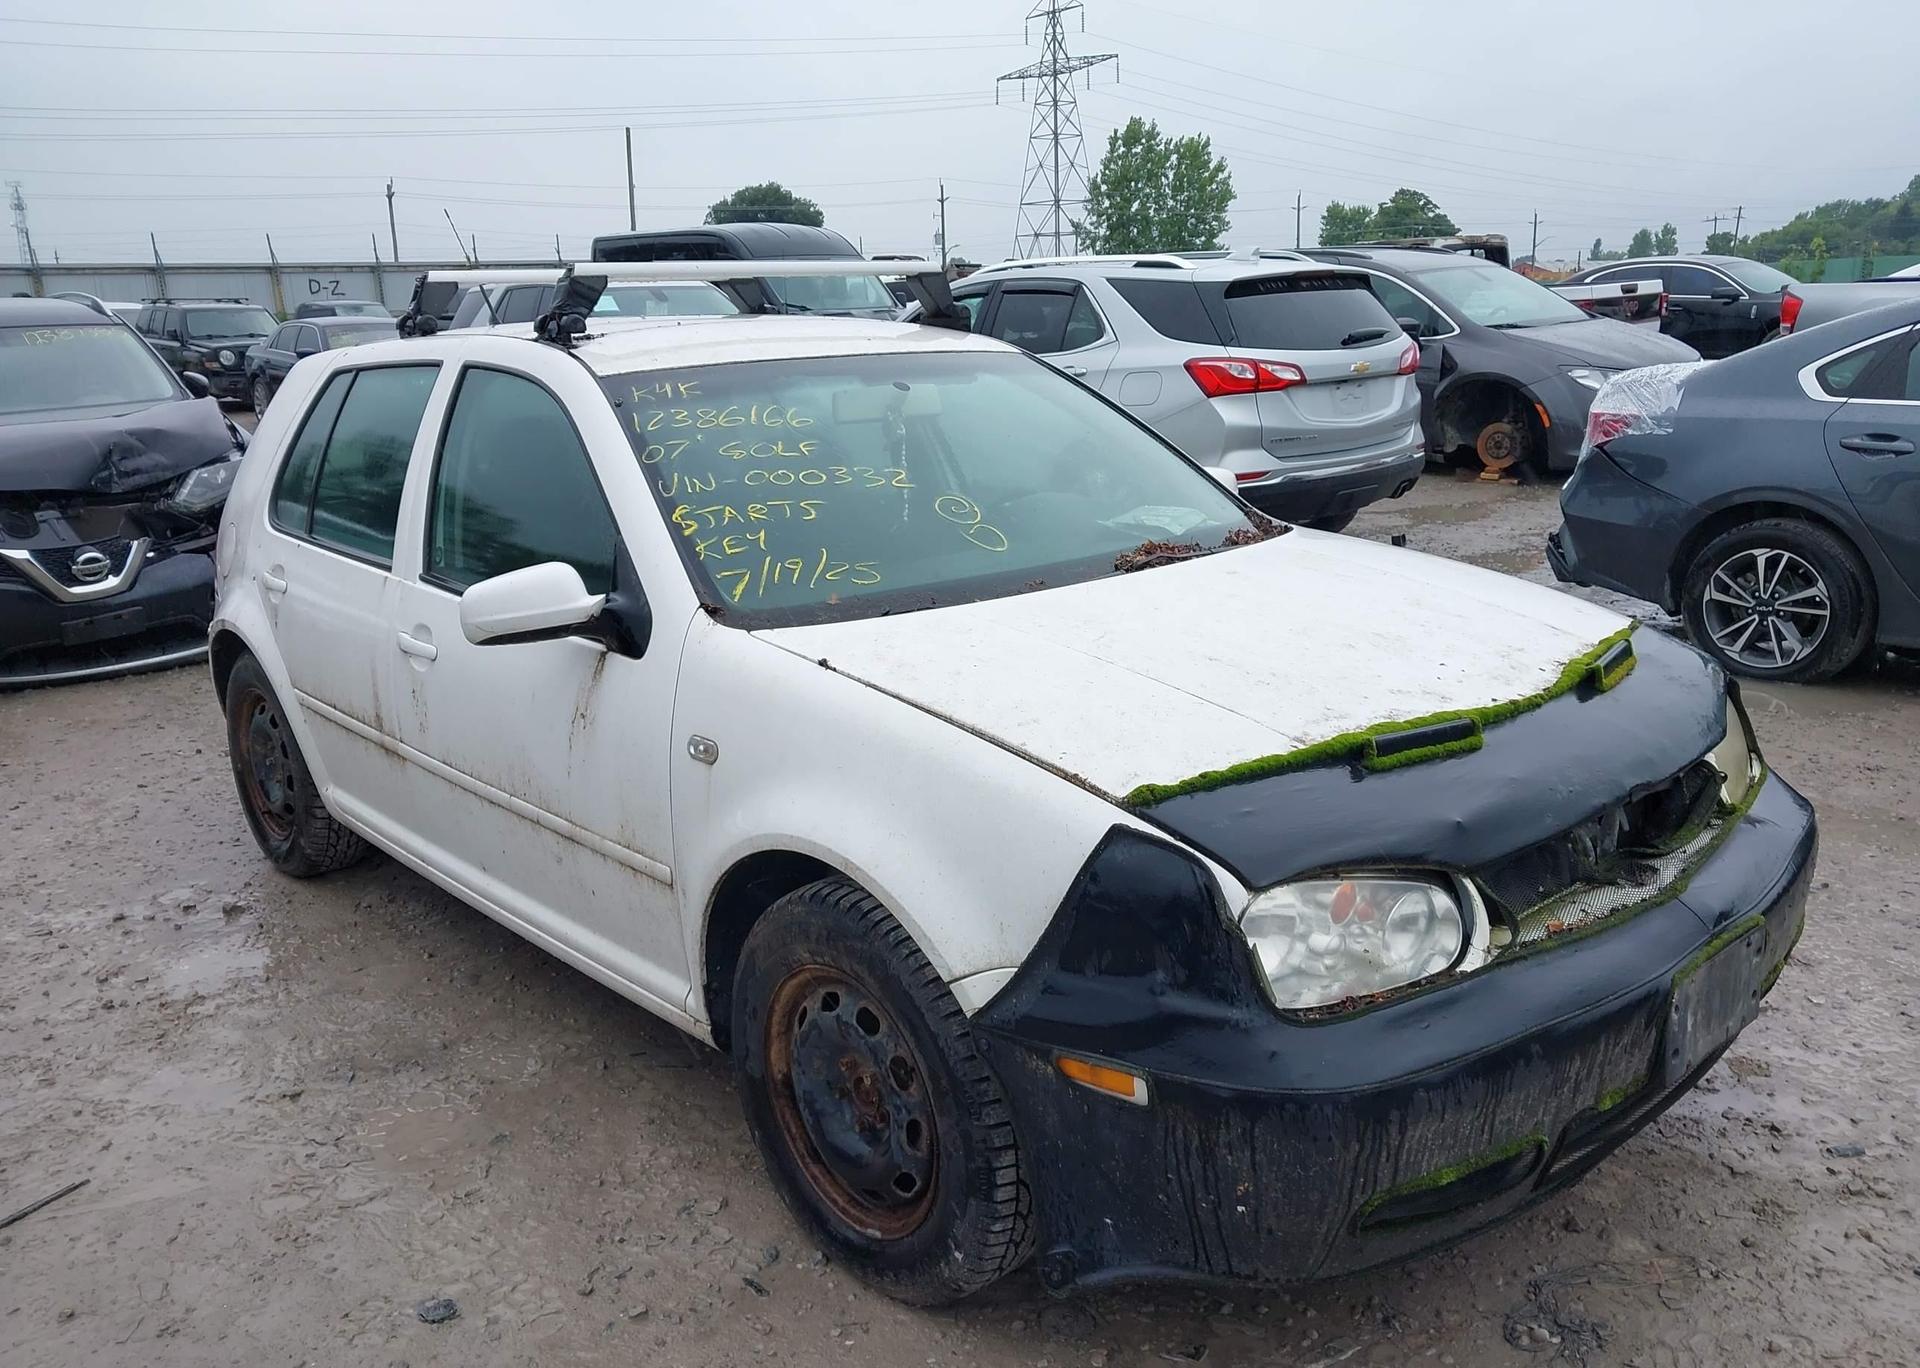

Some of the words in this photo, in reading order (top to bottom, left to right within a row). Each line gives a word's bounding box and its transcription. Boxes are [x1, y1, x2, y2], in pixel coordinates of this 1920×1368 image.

[633, 404, 814, 434] 12386166
[718, 440, 820, 461] GOLF
[671, 500, 828, 536] STARTS
[695, 528, 767, 560] KEY
[715, 547, 882, 602] 7/19/25
